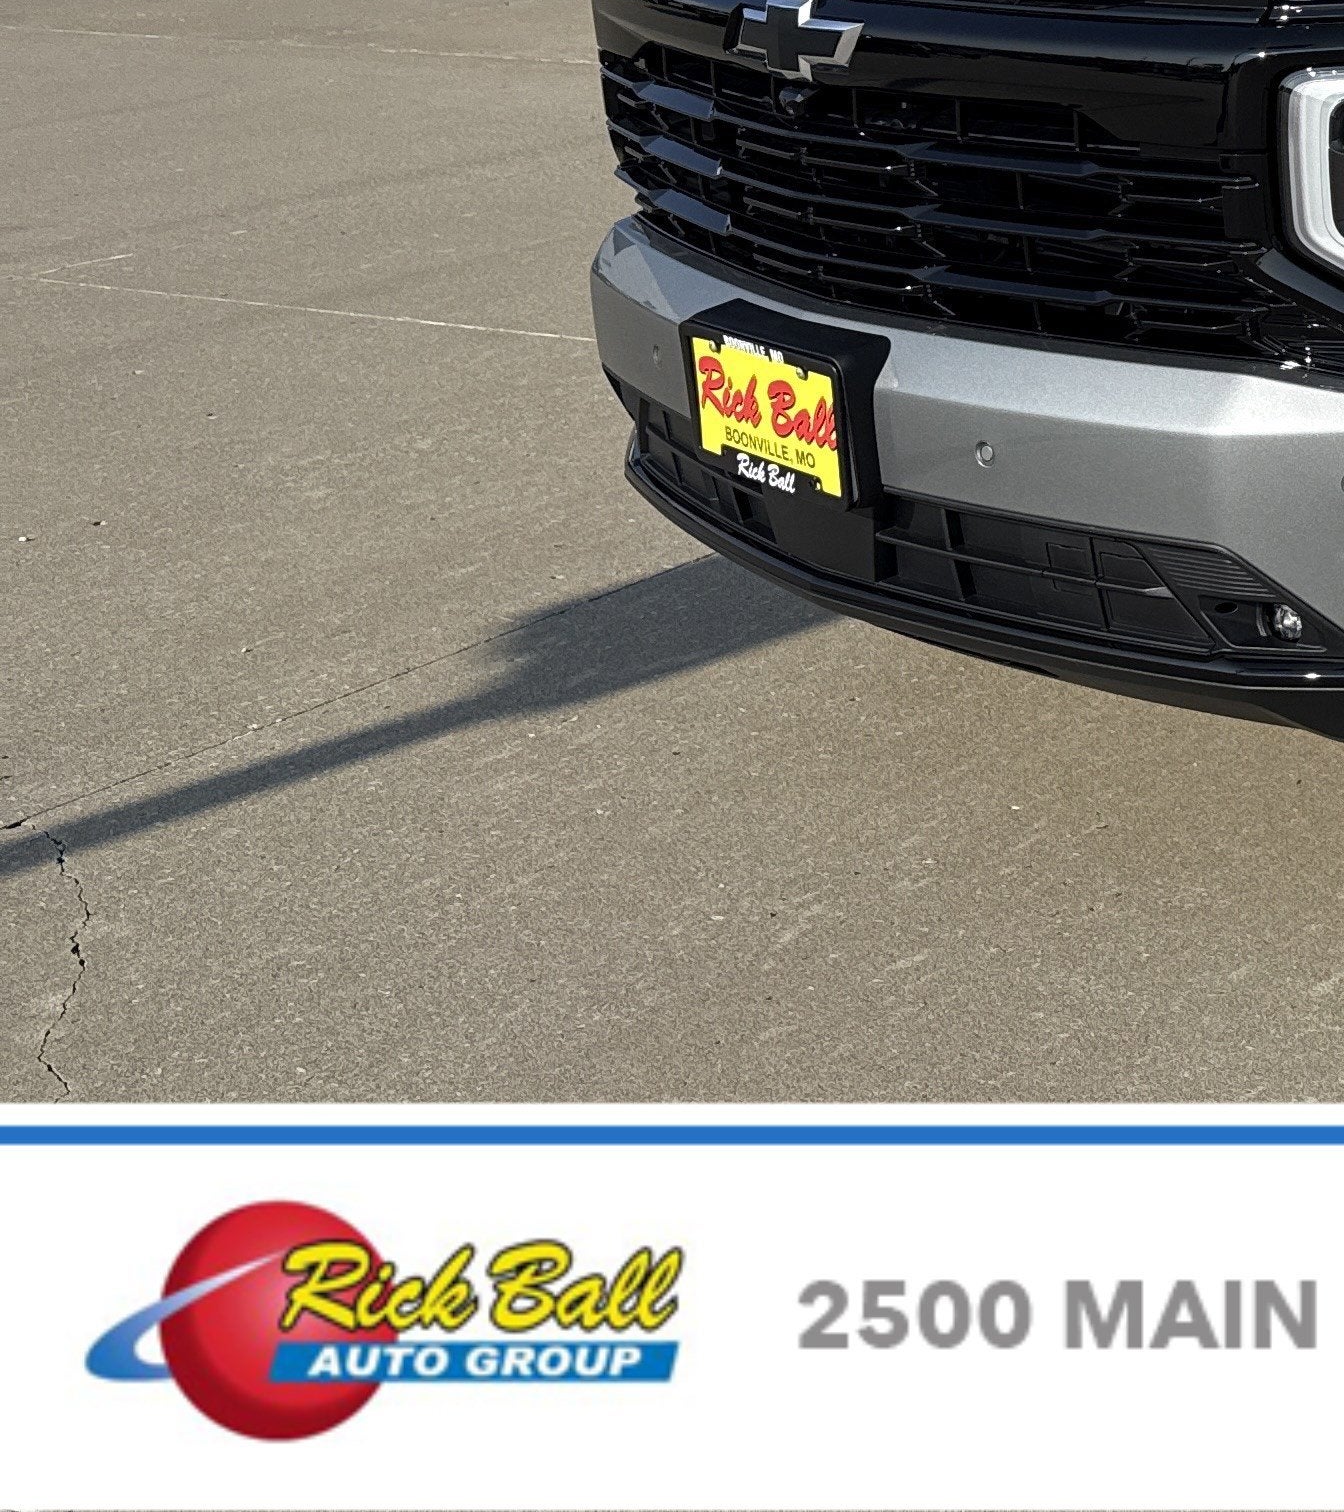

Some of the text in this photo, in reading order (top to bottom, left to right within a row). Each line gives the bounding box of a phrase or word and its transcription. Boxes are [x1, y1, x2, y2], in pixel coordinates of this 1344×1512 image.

[699, 356, 837, 450] Rick Ball
[725, 426, 816, 468] BOONVILLE, MO
[736, 452, 796, 493] Rick Ball
